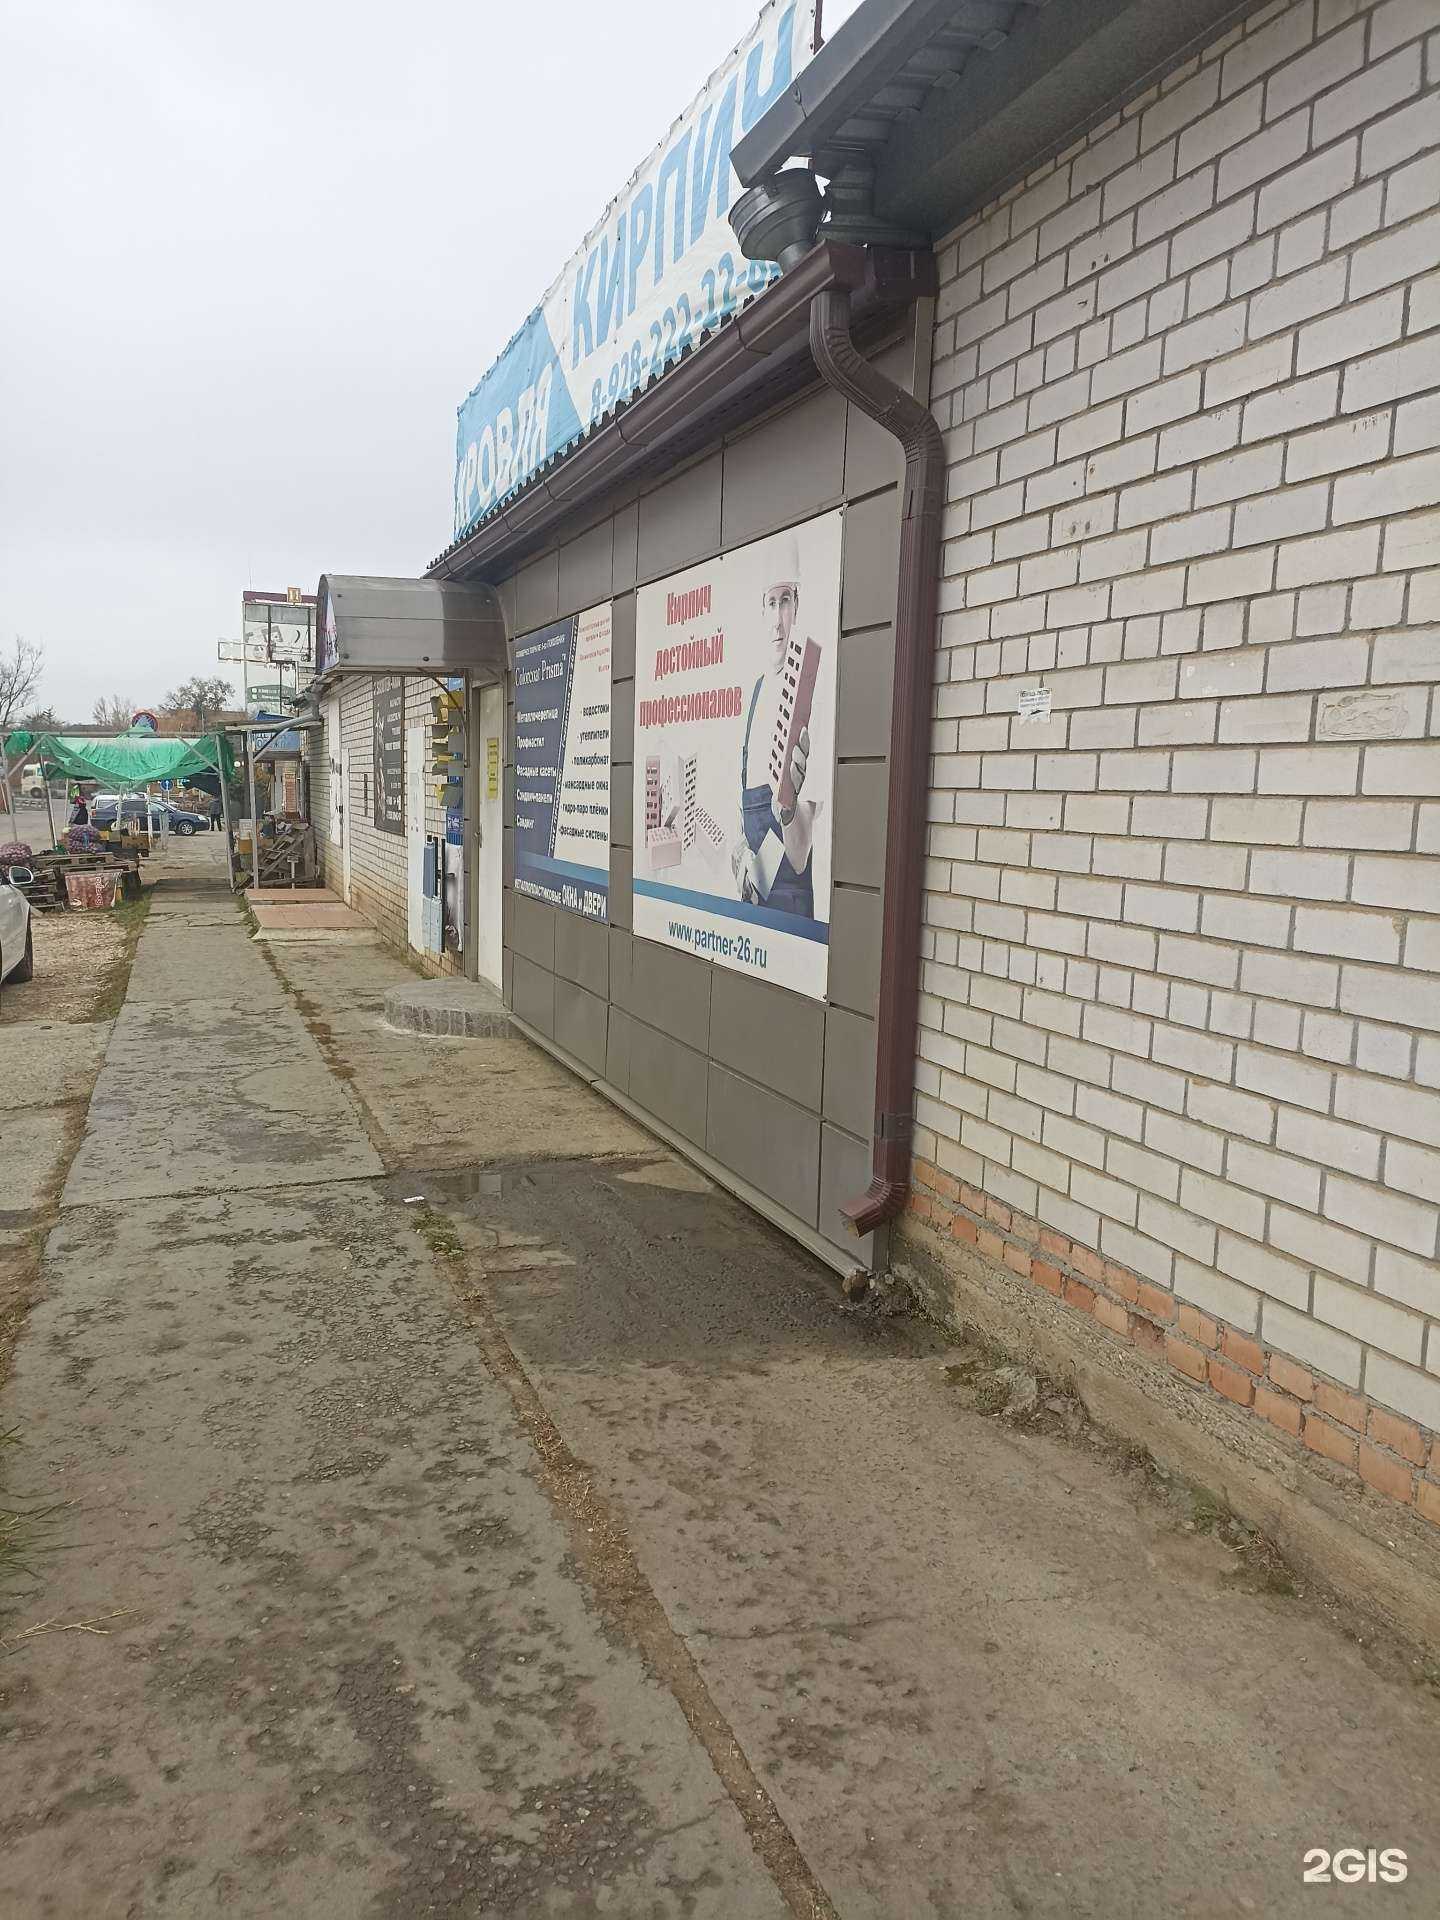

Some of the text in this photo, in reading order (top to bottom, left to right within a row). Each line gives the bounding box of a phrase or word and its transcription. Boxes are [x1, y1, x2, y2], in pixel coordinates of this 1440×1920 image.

[571, 3, 797, 369] КИРПИЧ
[666, 583, 712, 626] Кирпич
[655, 628, 724, 680] достойный
[639, 686, 742, 728] профессионалов
[596, 780, 609, 790] окна
[562, 884, 577, 908] ОКНА
[583, 891, 607, 918] ДВЕРИ
[668, 919, 768, 970] www.partner-26.ru
